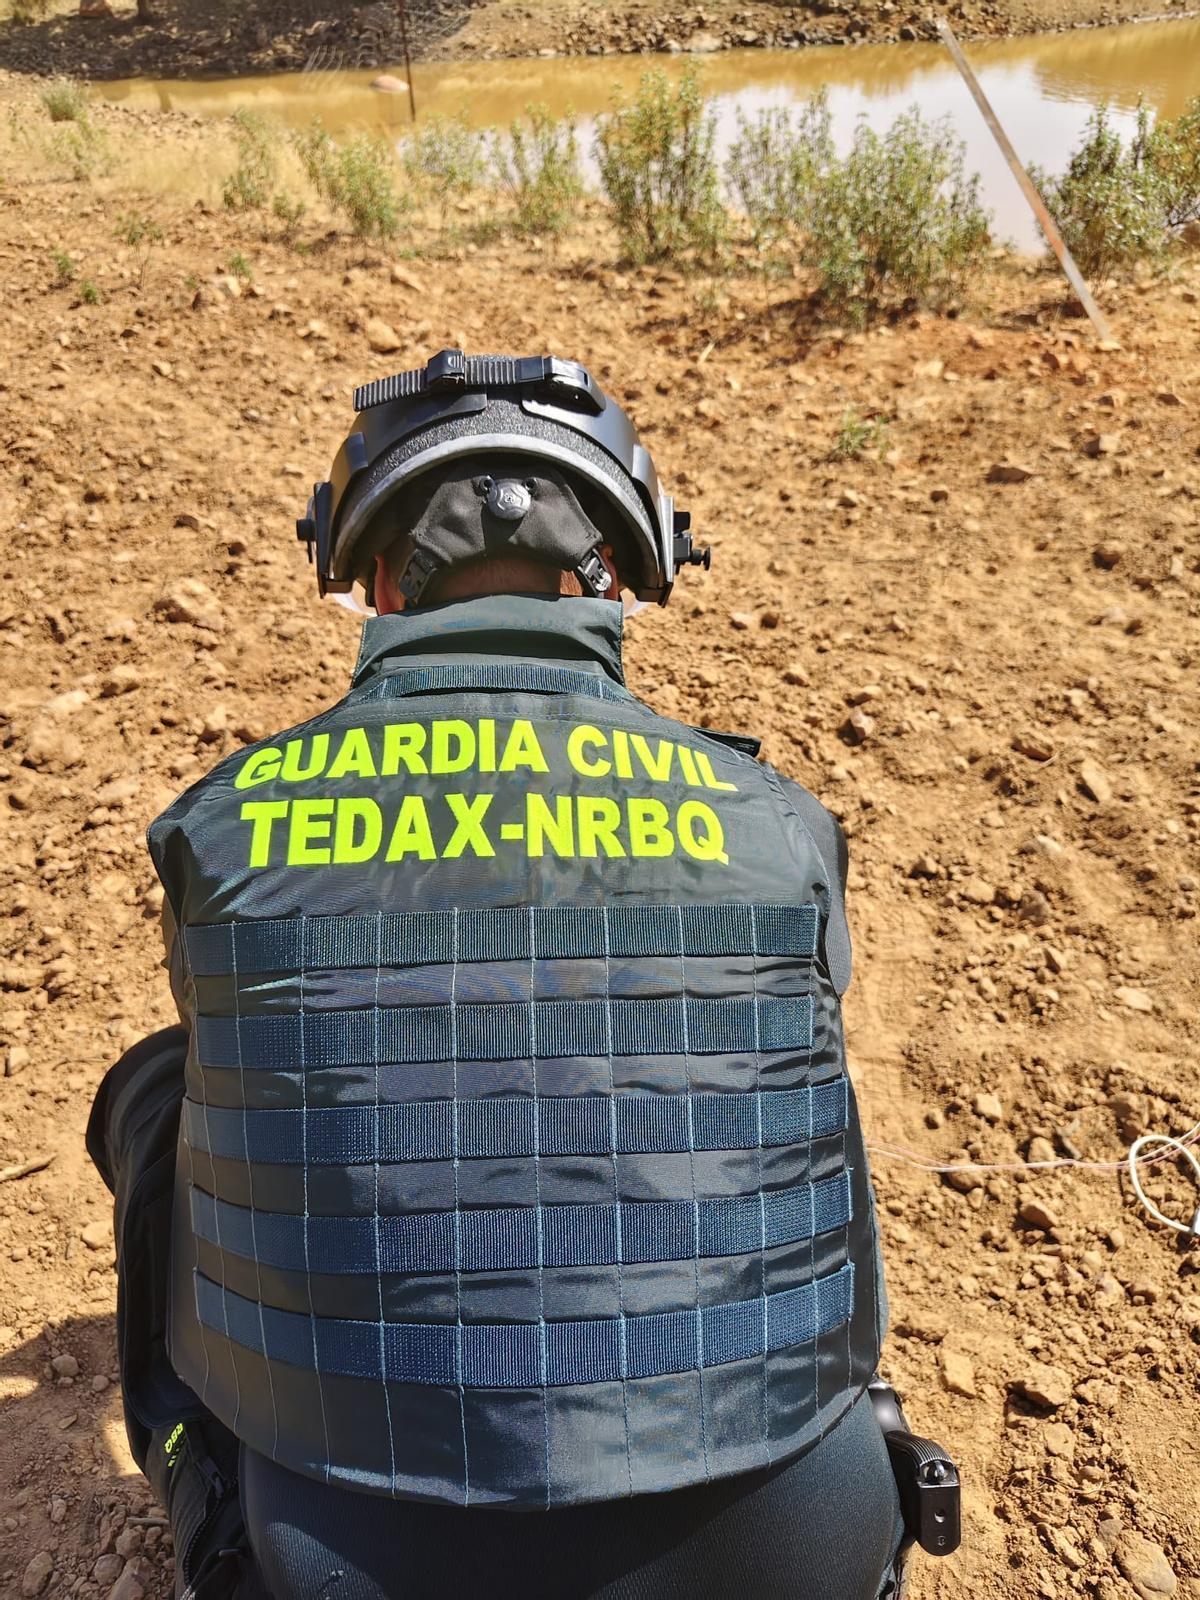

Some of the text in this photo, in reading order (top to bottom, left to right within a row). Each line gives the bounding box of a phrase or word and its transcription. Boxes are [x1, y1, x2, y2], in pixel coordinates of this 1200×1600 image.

[235, 718, 738, 791] GUARDIA CIVIL
[240, 793, 729, 867] TEDAX-NRBQ
